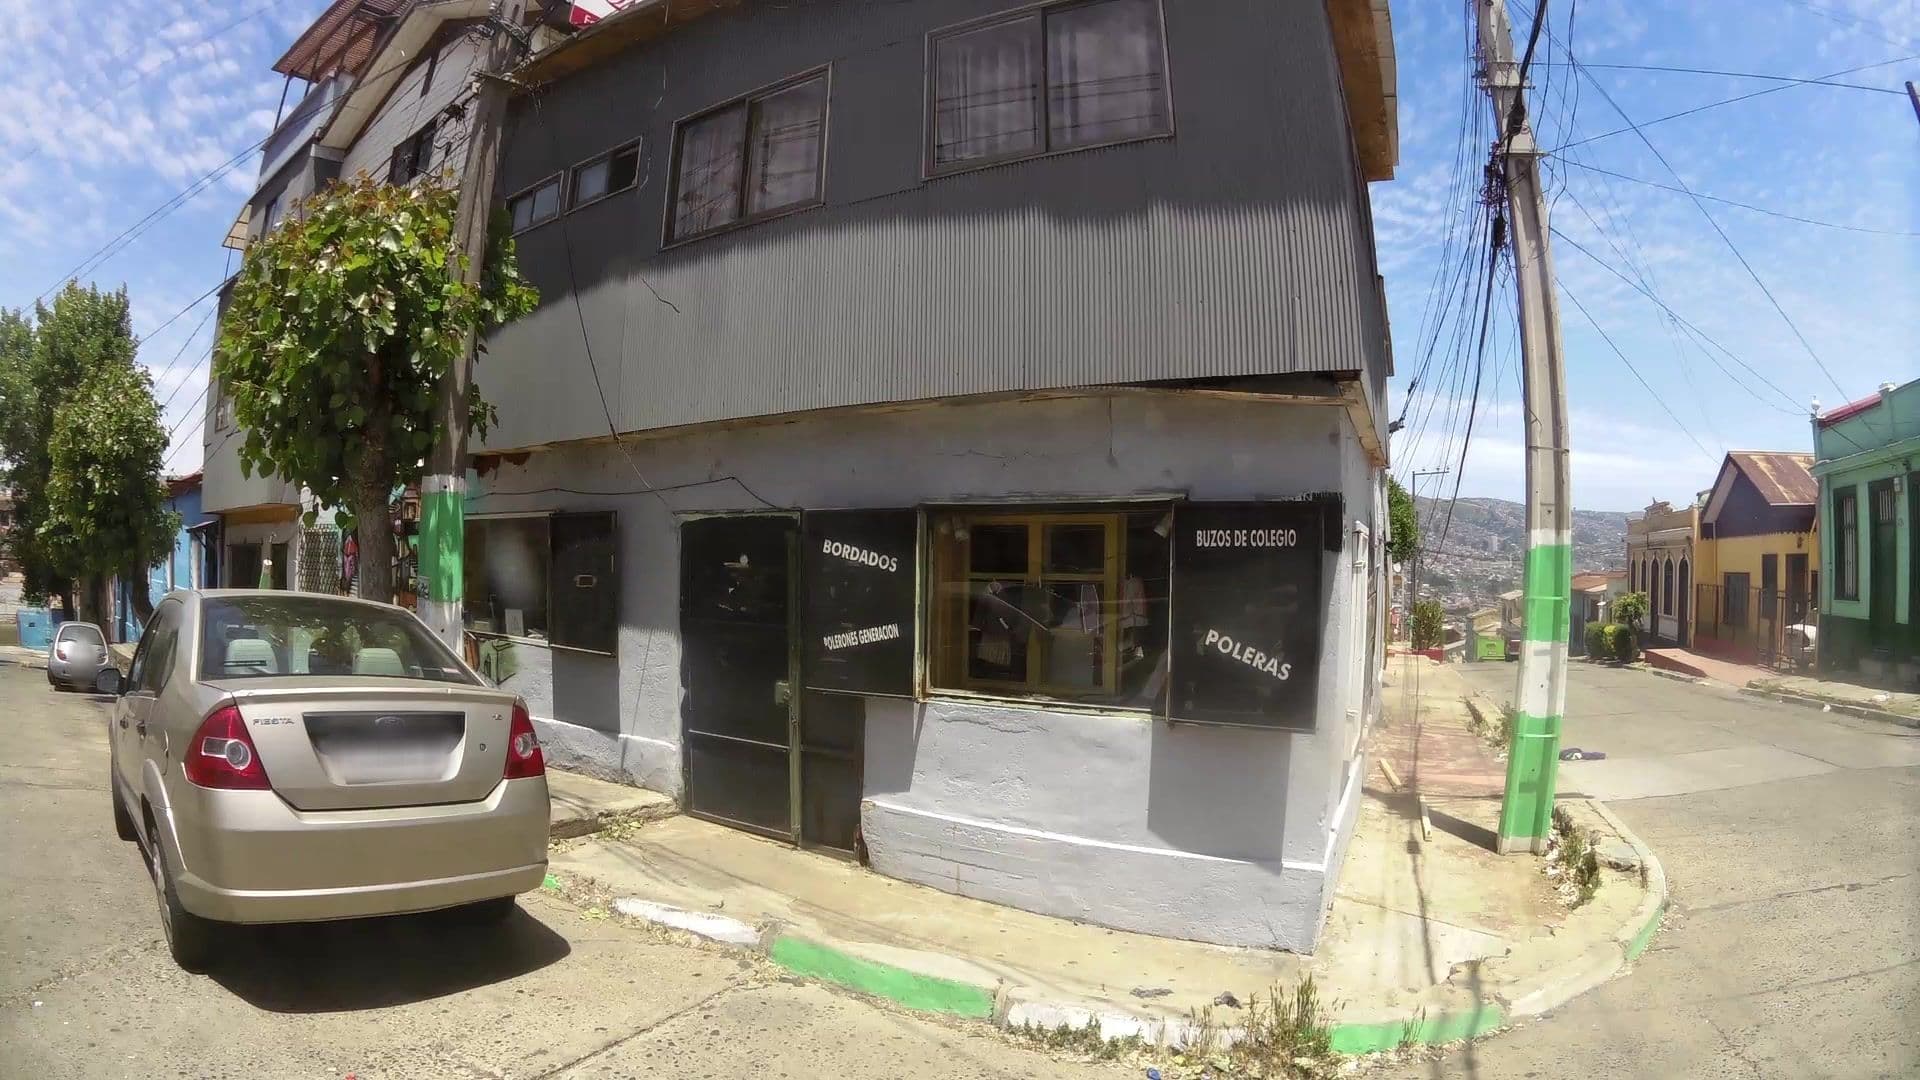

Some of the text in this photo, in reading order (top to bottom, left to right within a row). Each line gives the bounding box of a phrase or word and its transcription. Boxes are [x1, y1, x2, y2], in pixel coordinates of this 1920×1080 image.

[1196, 529, 1297, 547] BUZOS DE COLEGIO
[822, 539, 898, 572] BORDADOS
[823, 623, 900, 650] POLERONES GENERACION
[1204, 629, 1292, 681] POLERAS
